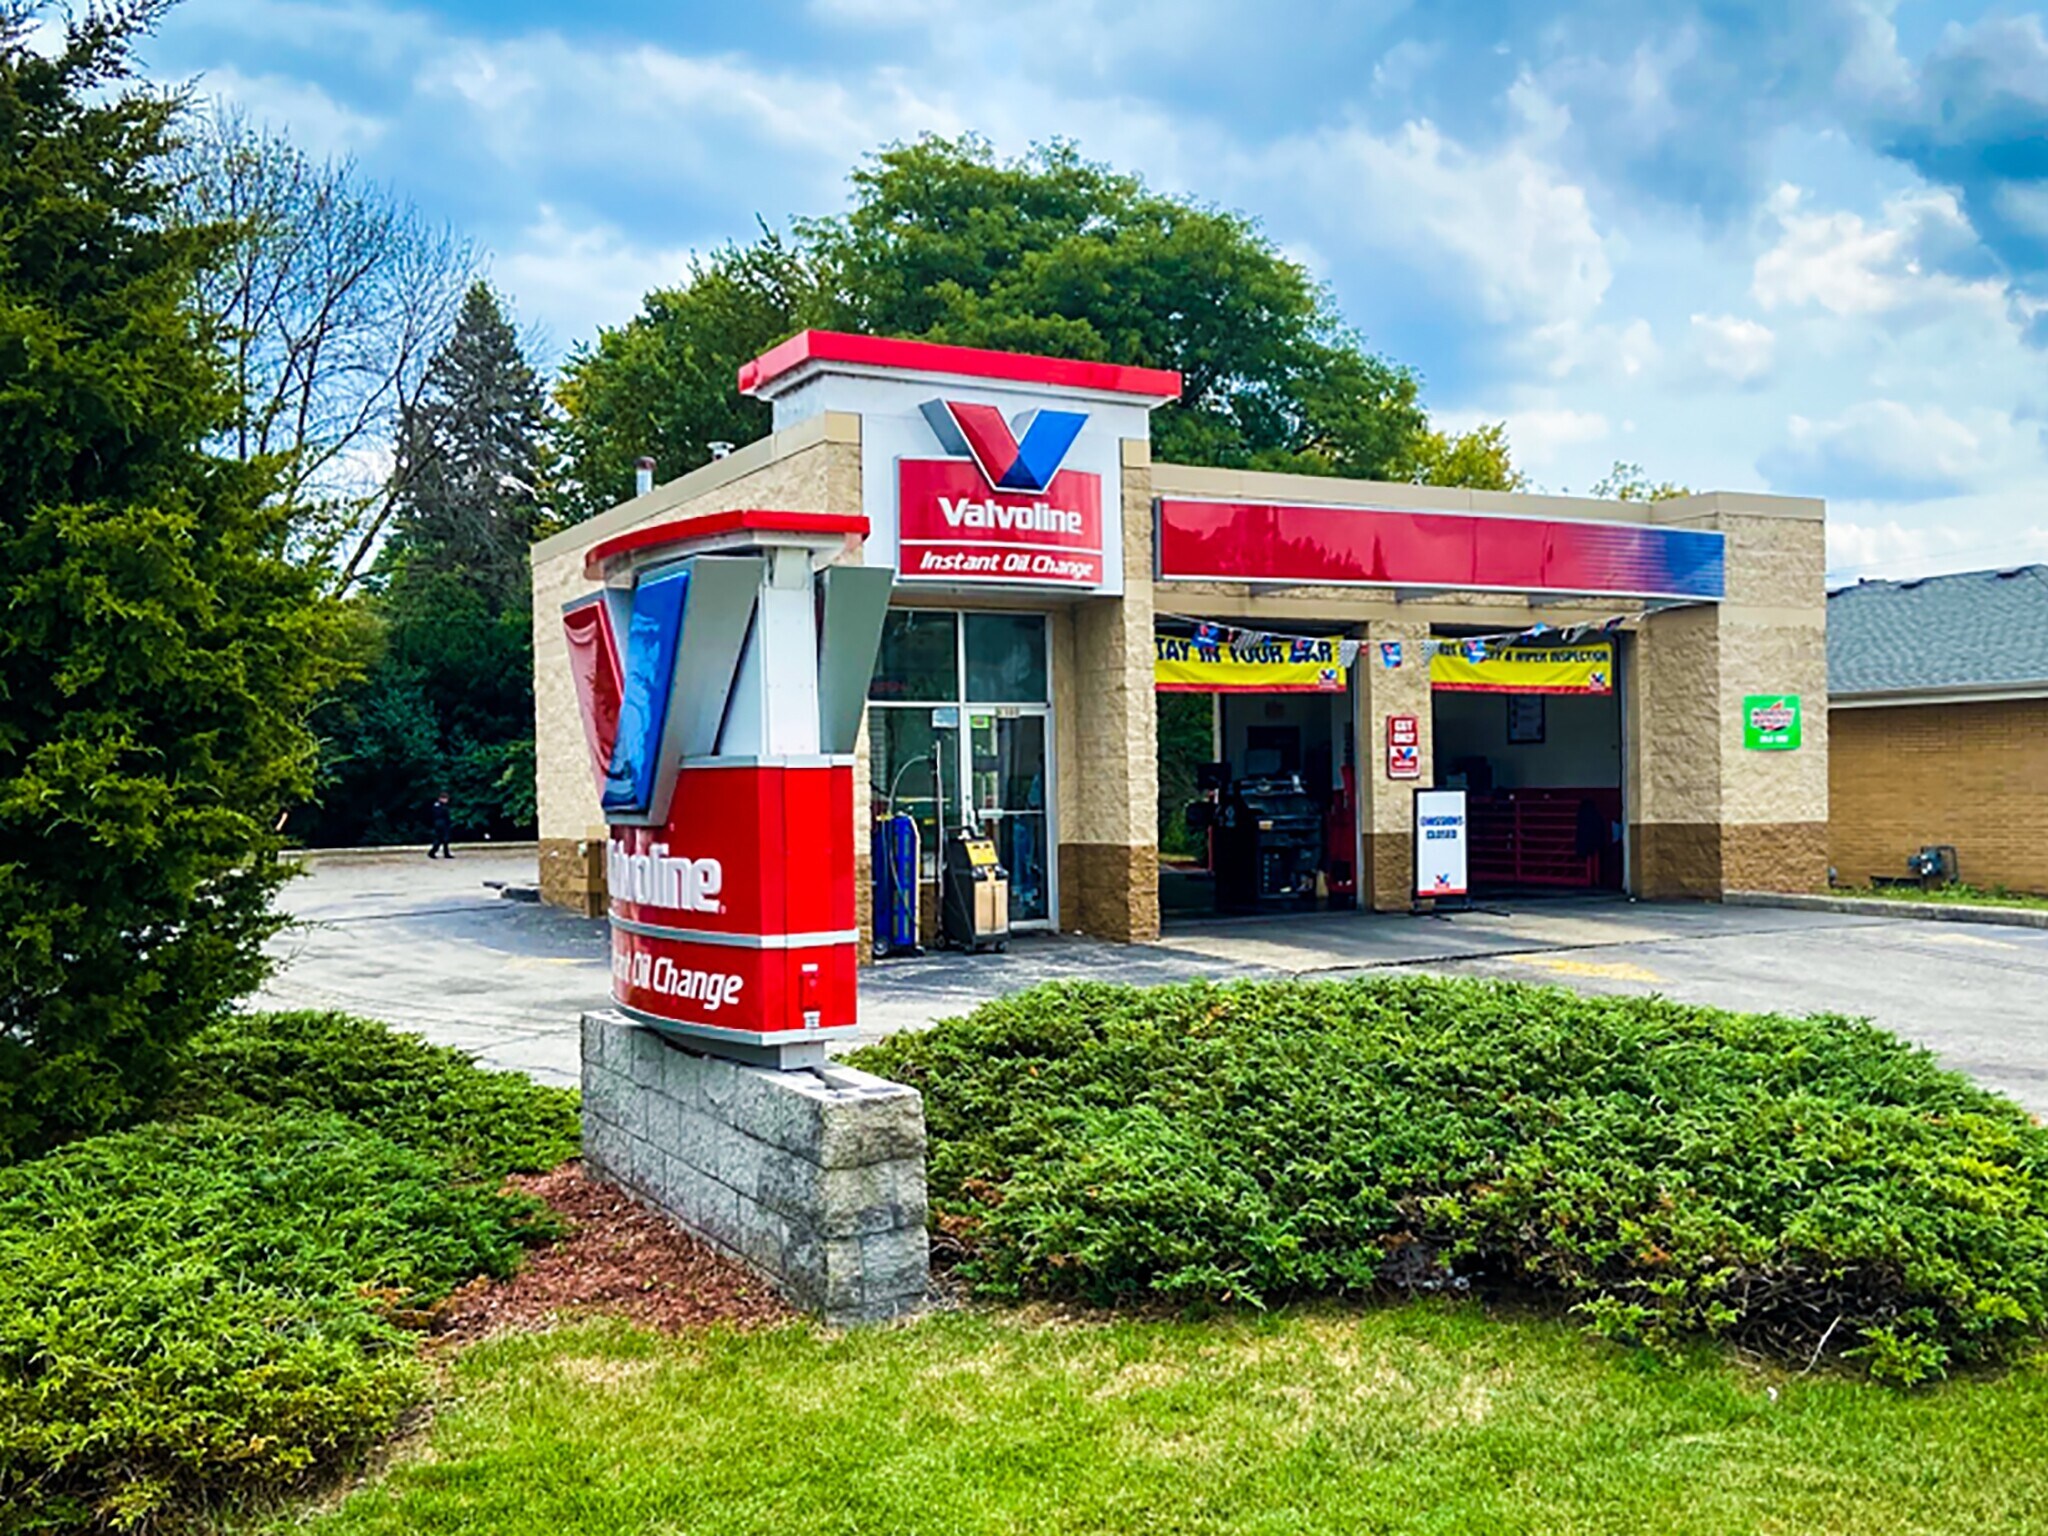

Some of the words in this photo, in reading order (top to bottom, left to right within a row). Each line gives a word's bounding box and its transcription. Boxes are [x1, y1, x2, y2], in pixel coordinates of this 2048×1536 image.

[937, 497, 1083, 534] Valvoline
[920, 551, 998, 571] Instant
[1002, 553, 1028, 571] Oil
[1031, 555, 1094, 578] Change
[1155, 637, 1191, 661] TAY
[607, 838, 723, 913] lvoline
[653, 956, 744, 1011] Change
